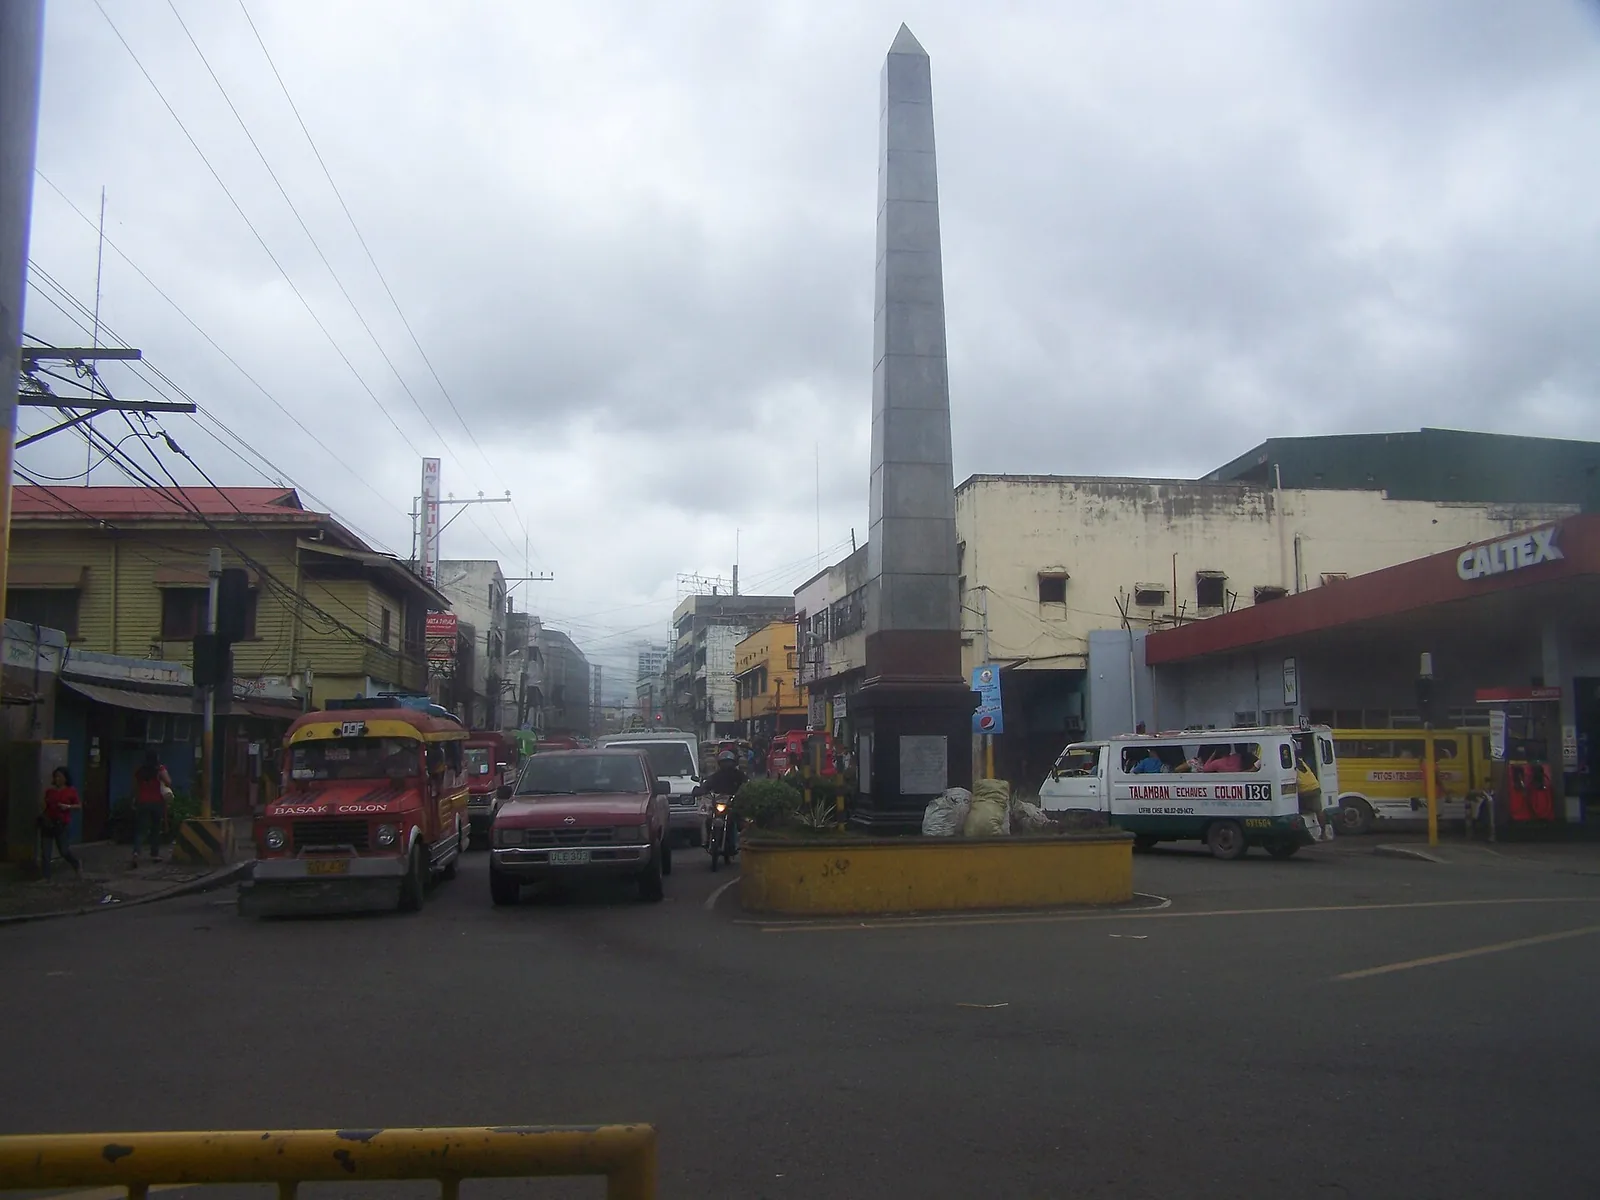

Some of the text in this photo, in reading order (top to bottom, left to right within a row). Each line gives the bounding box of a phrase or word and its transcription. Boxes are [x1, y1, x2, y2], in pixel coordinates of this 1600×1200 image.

[1456, 526, 1565, 581] CALTEX
[342, 722, 364, 737] 09F
[1129, 785, 1170, 799] TALAMBAN
[1176, 787, 1208, 798] ECHAVES
[1214, 785, 1243, 799] COLON
[1247, 784, 1270, 800] 13C
[274, 803, 388, 815] BASAK COLON
